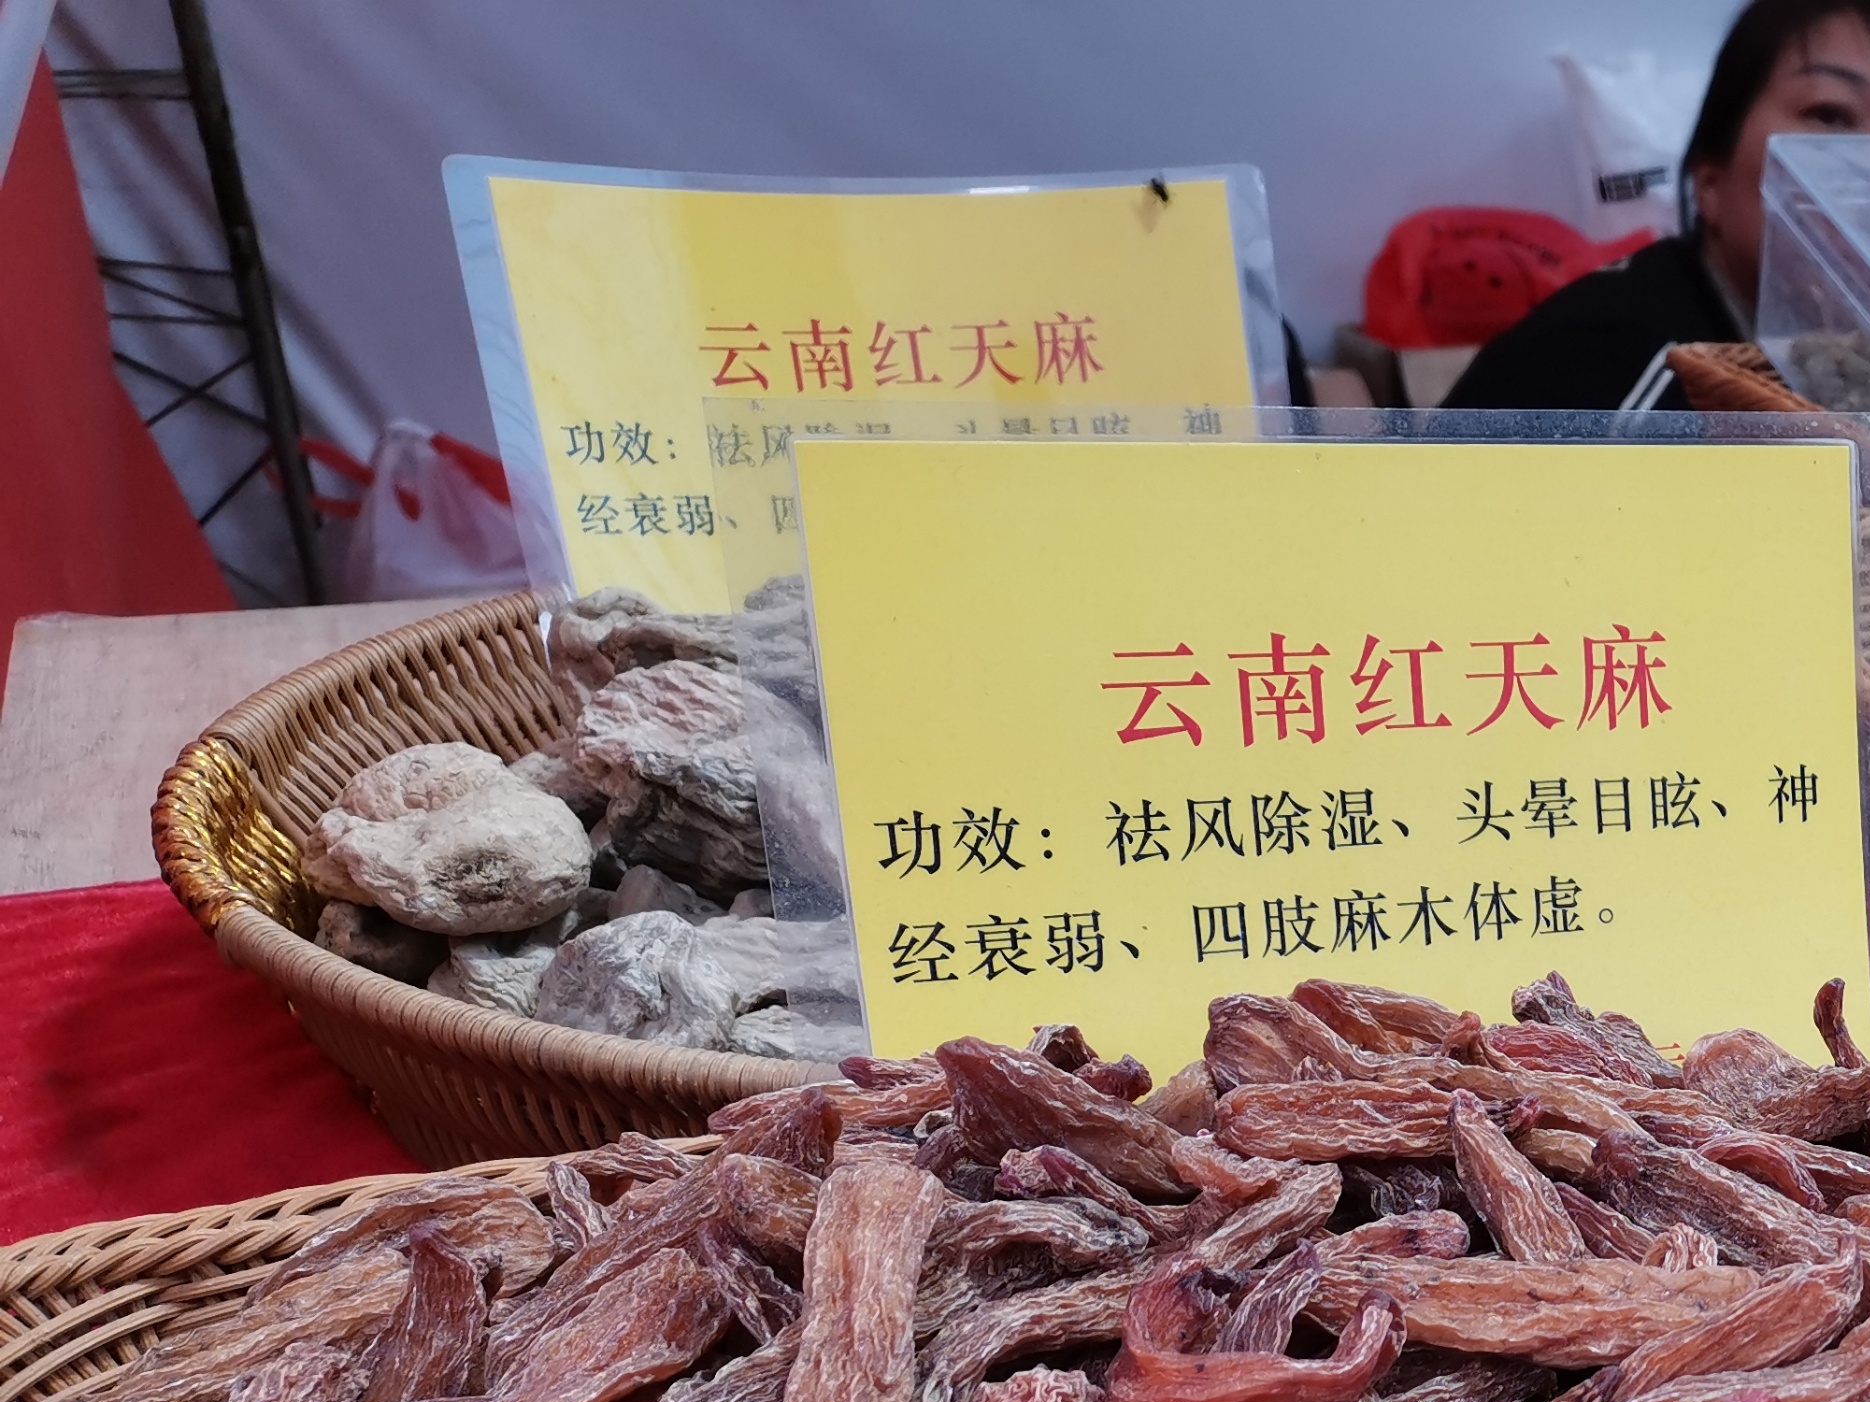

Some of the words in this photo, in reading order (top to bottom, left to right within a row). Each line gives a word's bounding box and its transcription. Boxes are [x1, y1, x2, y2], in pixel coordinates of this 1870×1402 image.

[698, 311, 1105, 393] 云南红天麻
[1099, 622, 1674, 748] 云南红天麻
[886, 875, 1618, 985] 经衰弱、四肢麻木体虚。
